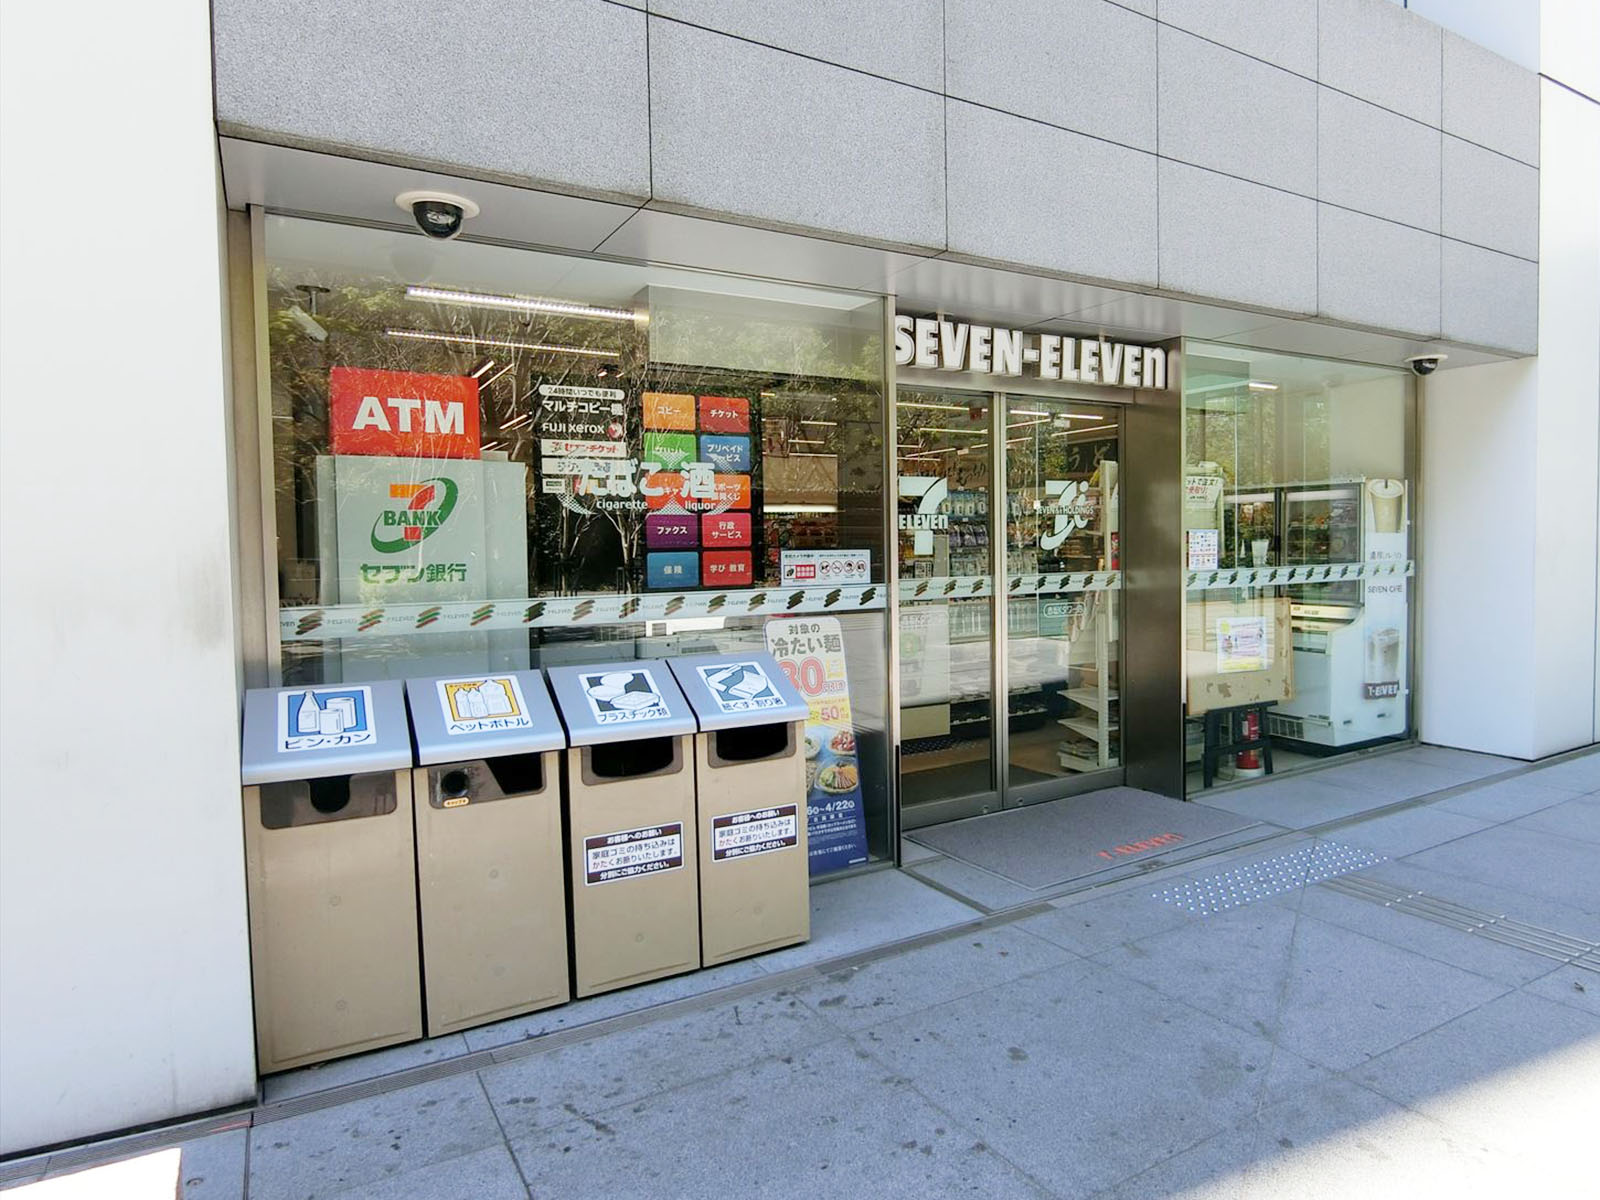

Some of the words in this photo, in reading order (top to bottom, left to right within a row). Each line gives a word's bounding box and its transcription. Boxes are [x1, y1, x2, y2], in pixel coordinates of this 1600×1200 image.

[352, 396, 464, 434] ATM
[541, 399, 624, 416] マルチコピー機
[657, 404, 681, 416] コピー
[709, 408, 740, 419] チケット
[541, 422, 566, 434] FUJI
[577, 457, 665, 497] たばこ
[680, 461, 717, 498] 酒
[596, 499, 648, 512] cigarette
[685, 499, 718, 513] liquor
[383, 509, 439, 528] BANK
[656, 525, 688, 536] ファクス
[711, 530, 743, 540] サービス
[359, 562, 468, 584] セブン銀行
[787, 623, 820, 635] 対象の
[771, 634, 841, 657] 冷たい麺
[598, 708, 668, 722] プラスチック類
[450, 717, 530, 732] ペットボトル
[284, 733, 371, 750] ビン・カン
[591, 837, 676, 860] 家庭ゴミの持ち込みは
